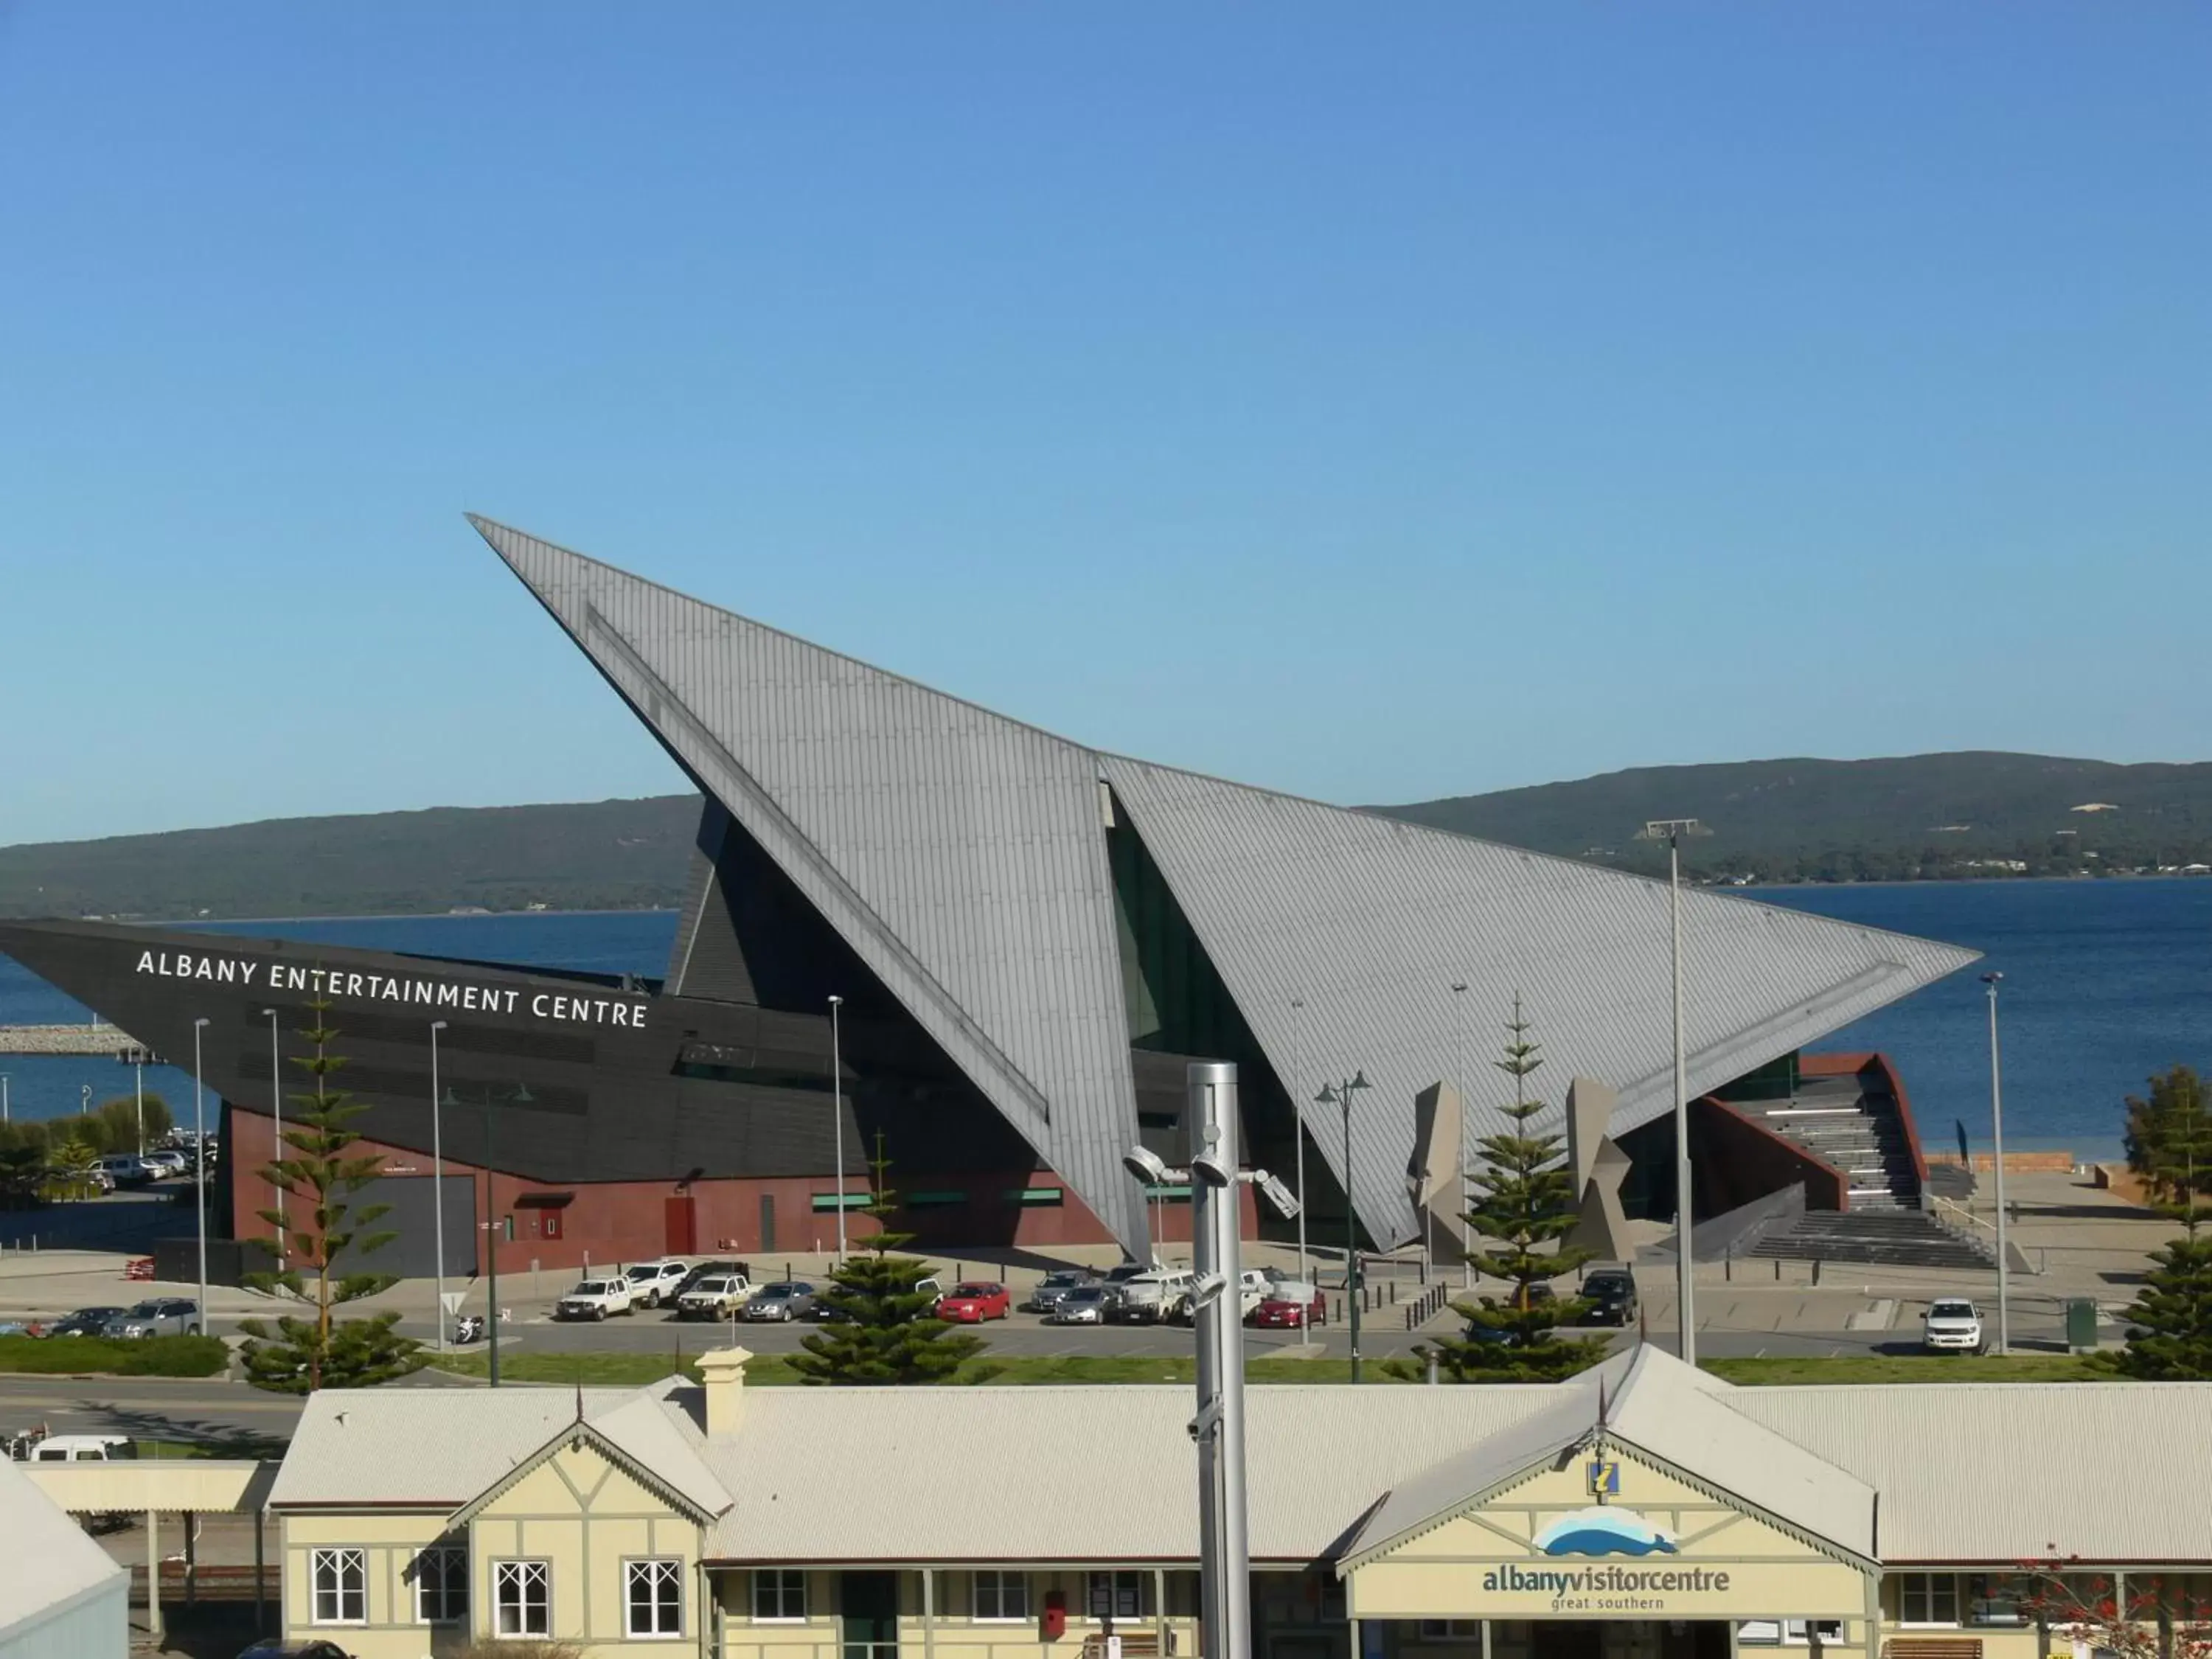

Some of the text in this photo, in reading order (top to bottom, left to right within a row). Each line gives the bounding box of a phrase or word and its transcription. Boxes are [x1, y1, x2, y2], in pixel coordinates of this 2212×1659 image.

[136, 950, 647, 1027] ALBANY ENTERTAINMENT CENTRE
[1551, 1596, 1664, 1612] great southern
